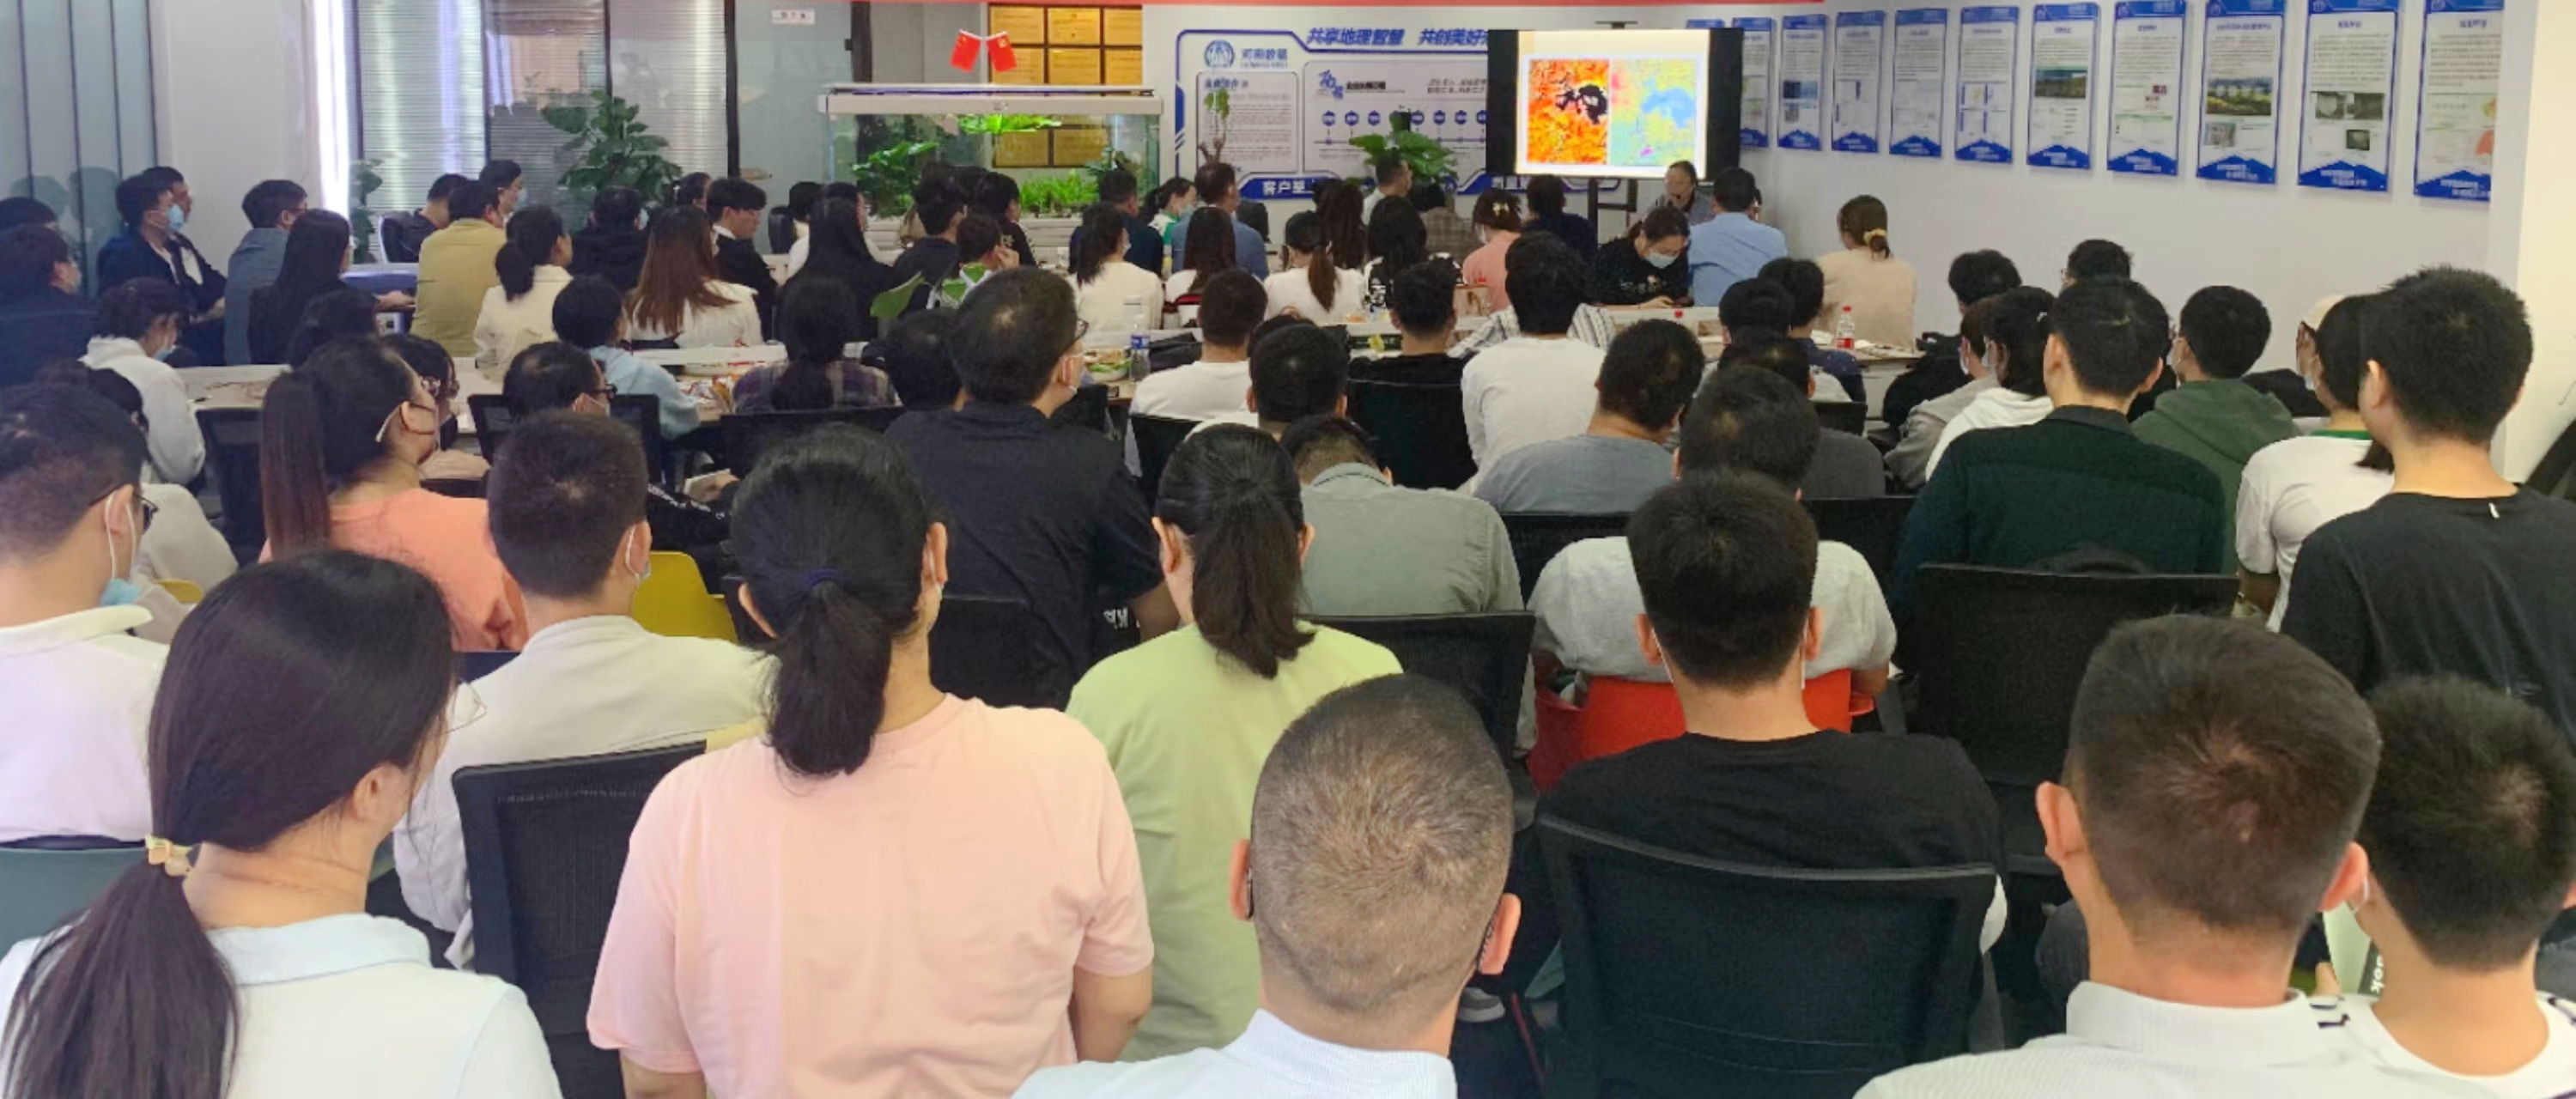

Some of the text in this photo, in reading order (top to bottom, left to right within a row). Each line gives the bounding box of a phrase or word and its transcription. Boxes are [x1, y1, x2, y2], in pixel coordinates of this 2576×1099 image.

[1307, 27, 1405, 46] 共享地理智慧
